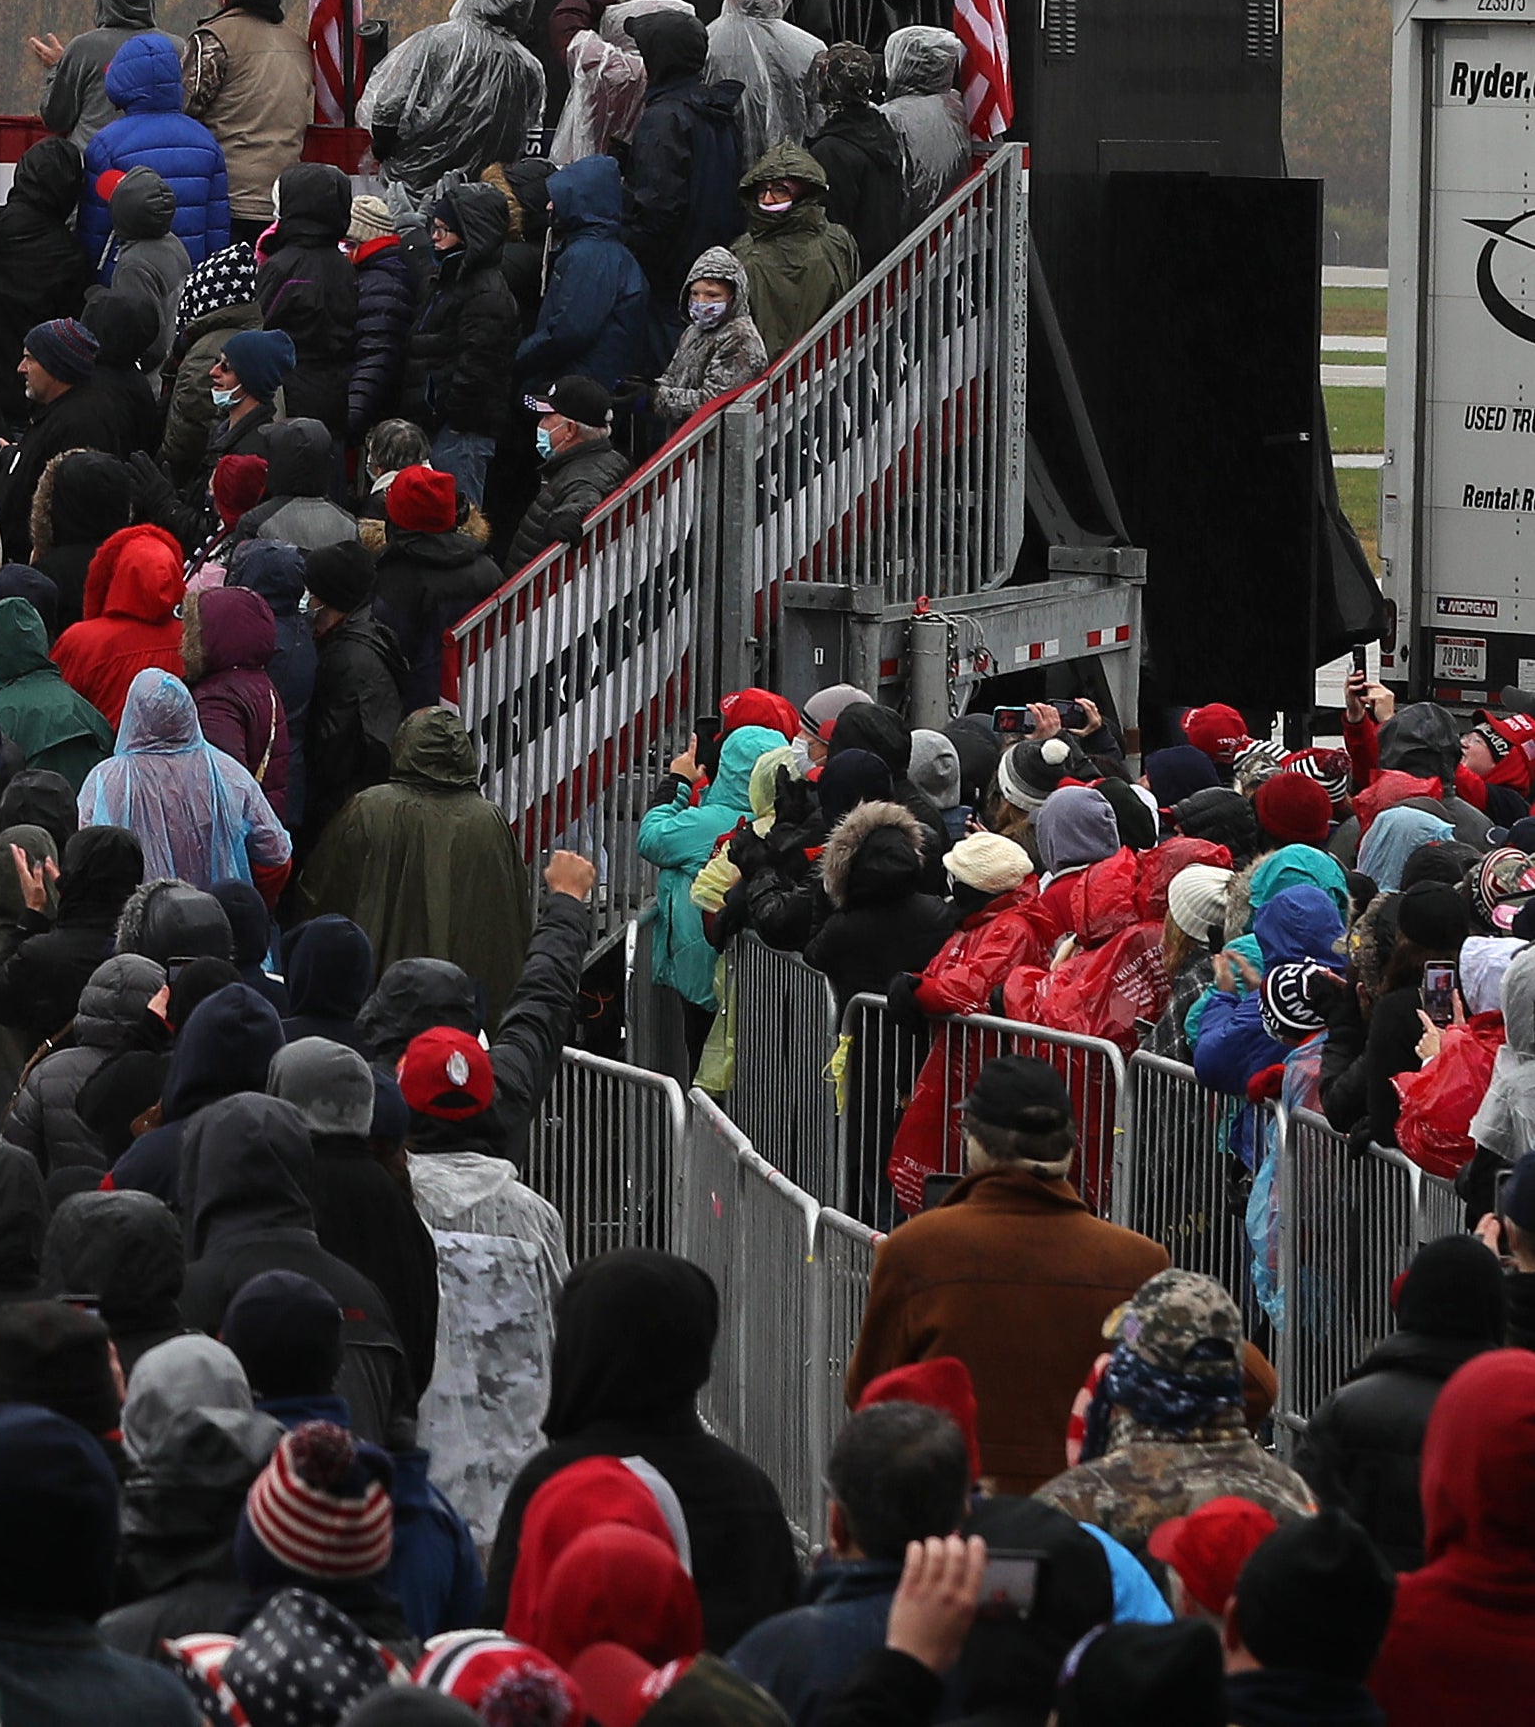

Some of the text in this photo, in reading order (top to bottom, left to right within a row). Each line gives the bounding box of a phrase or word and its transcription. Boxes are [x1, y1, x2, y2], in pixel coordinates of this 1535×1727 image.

[1450, 61, 1535, 105] Ryder.
[1464, 405, 1507, 431] USED
[1462, 484, 1519, 511] Rental
[1448, 600, 1496, 616] MORGAN
[1111, 956, 1143, 984] TRUMP
[1278, 963, 1326, 1023] RUM
